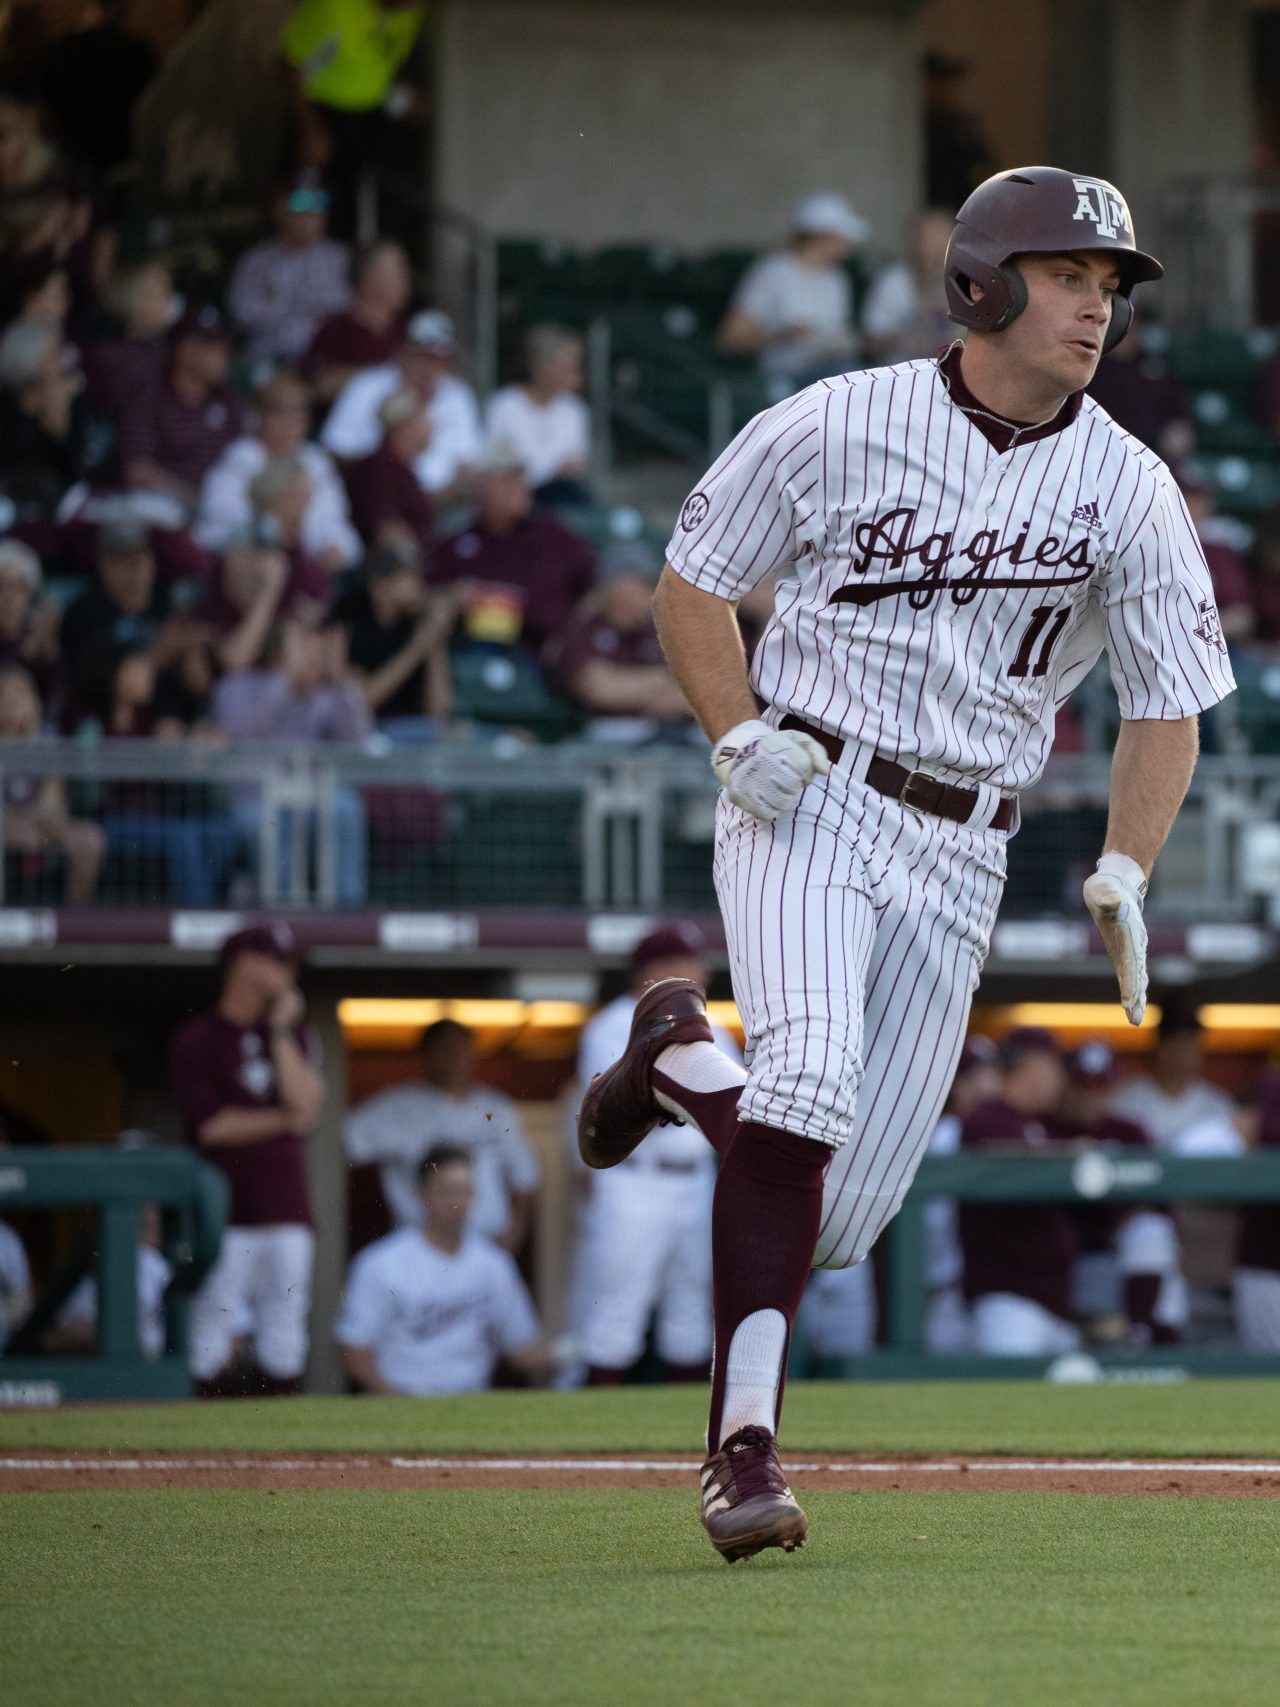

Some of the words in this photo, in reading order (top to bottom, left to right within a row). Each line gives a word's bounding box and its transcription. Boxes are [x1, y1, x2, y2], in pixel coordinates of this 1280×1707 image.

[1071, 510, 1103, 529] adidas
[853, 508, 1093, 610] Aggies
[1007, 605, 1073, 677] 11
